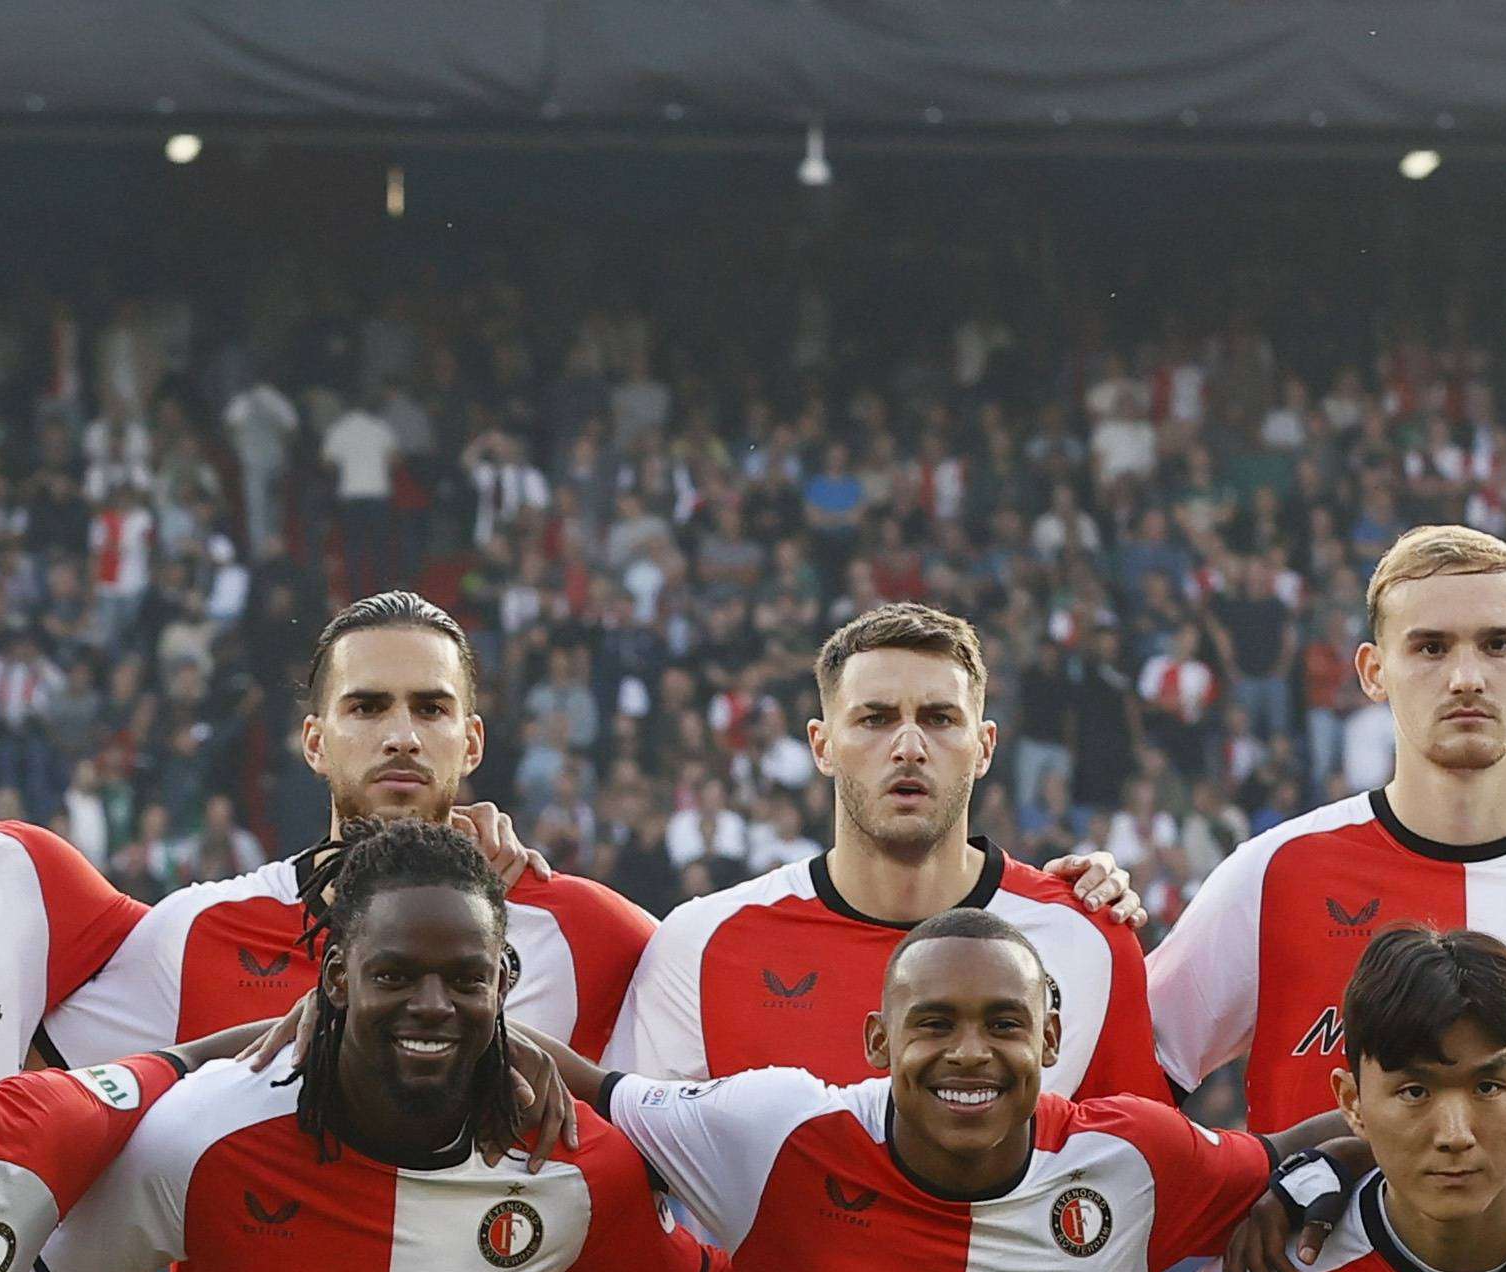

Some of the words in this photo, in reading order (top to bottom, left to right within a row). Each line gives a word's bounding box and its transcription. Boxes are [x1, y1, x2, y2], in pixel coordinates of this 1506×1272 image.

[1054, 1189, 1107, 1216] FEYENOORD
[500, 1219, 524, 1250] F
[1068, 1206, 1092, 1238] F
